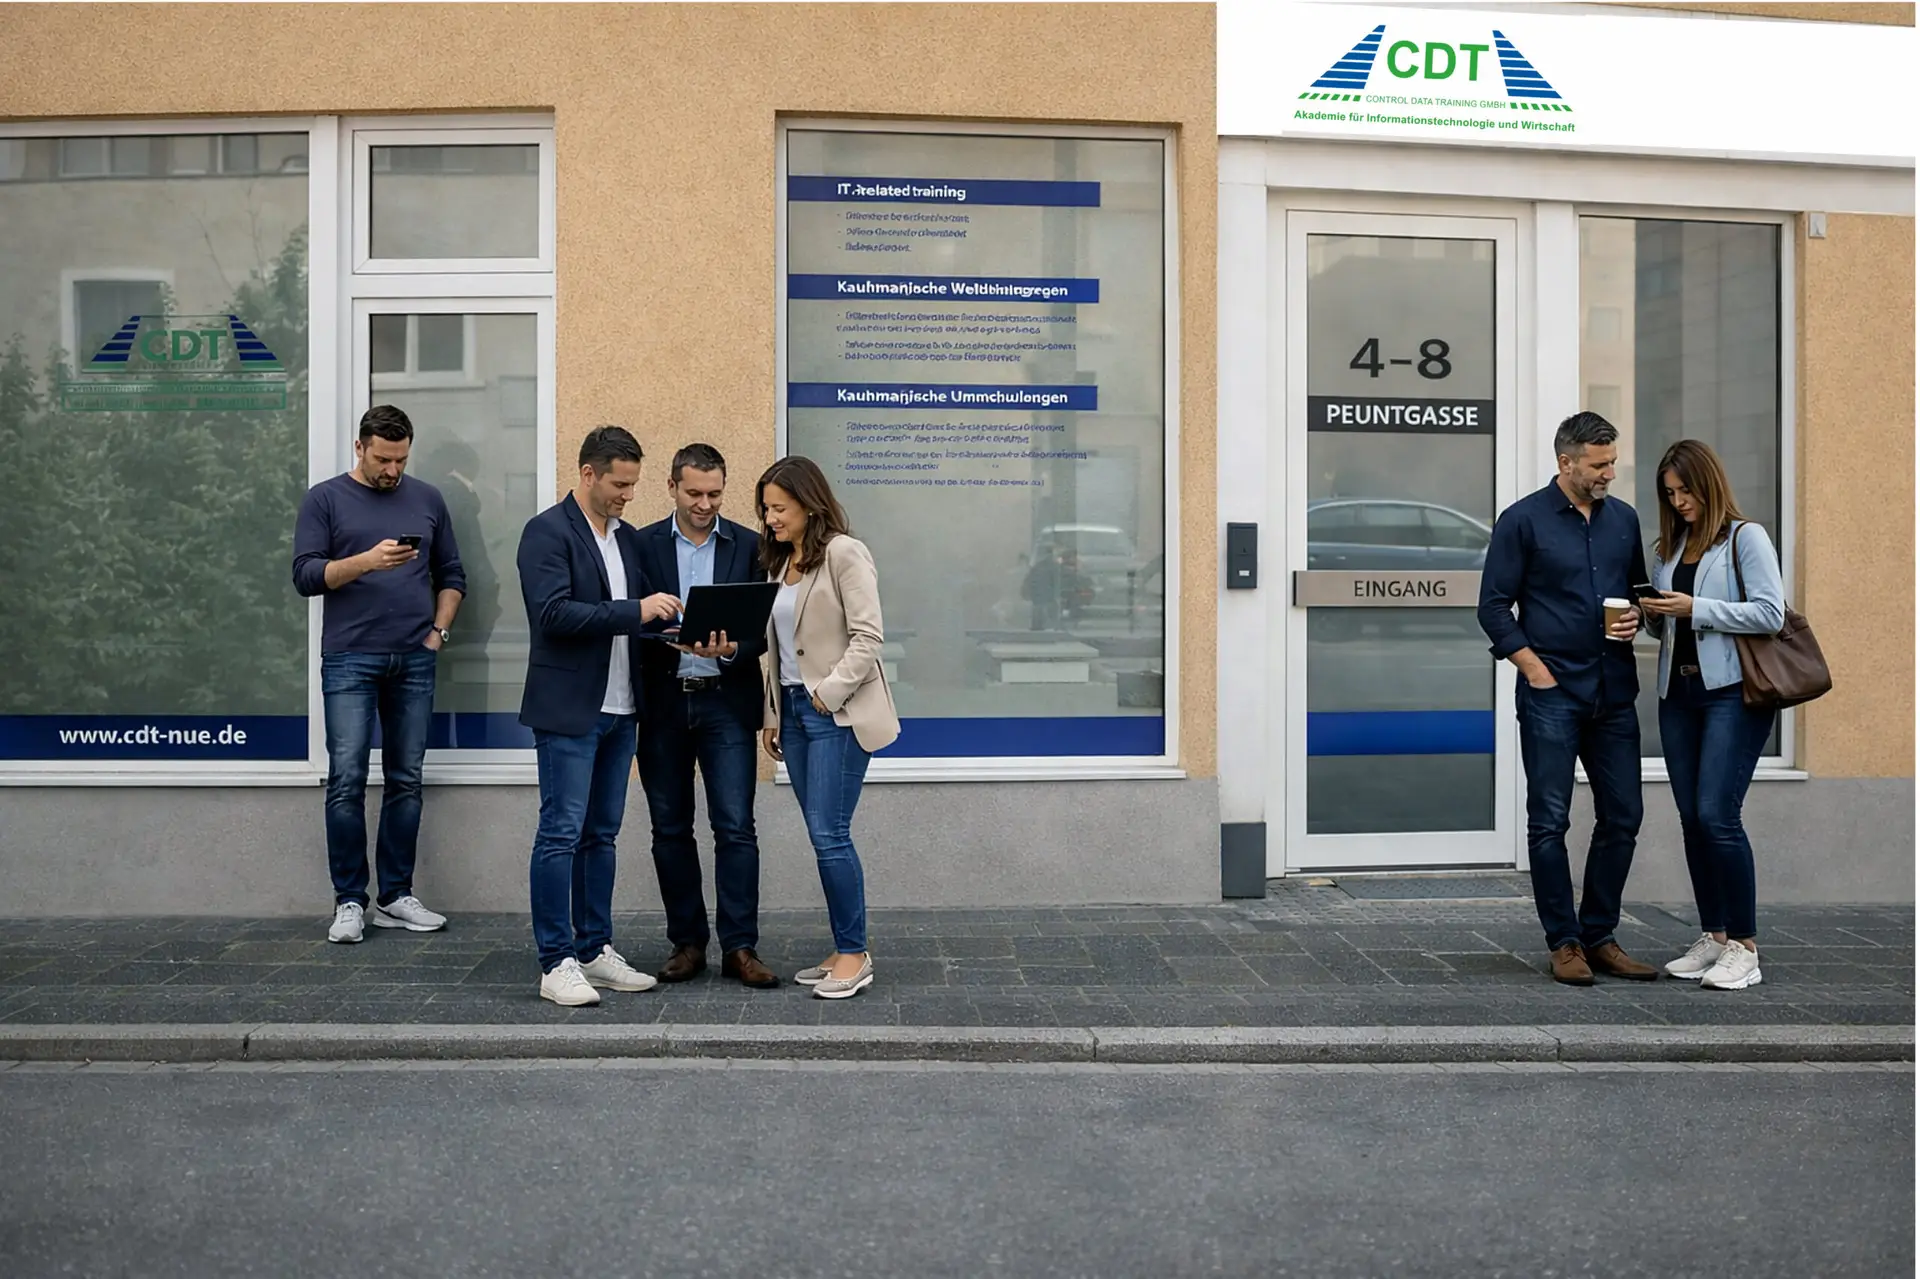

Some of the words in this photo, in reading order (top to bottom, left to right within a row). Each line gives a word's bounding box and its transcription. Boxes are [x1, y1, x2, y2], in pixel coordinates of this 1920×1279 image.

[1386, 39, 1490, 82] CDT
[1365, 94, 1408, 105] CONTROL
[1410, 96, 1433, 106] DATA
[1434, 98, 1478, 108] TRAINING
[1479, 100, 1506, 109] GMBH
[1293, 110, 1347, 122] Akademie
[1348, 111, 1364, 123] für
[1366, 113, 1496, 130] Informationstechnologie
[1497, 118, 1519, 130] und
[1520, 120, 1576, 133] Wirtschaft
[912, 184, 967, 201] training
[140, 329, 228, 362] CDT
[1349, 337, 1452, 380] 4-8
[1326, 404, 1479, 426] PEUNTGASSE
[1354, 580, 1446, 598] EINGANG
[58, 724, 248, 746] www.cdt-nue.de
